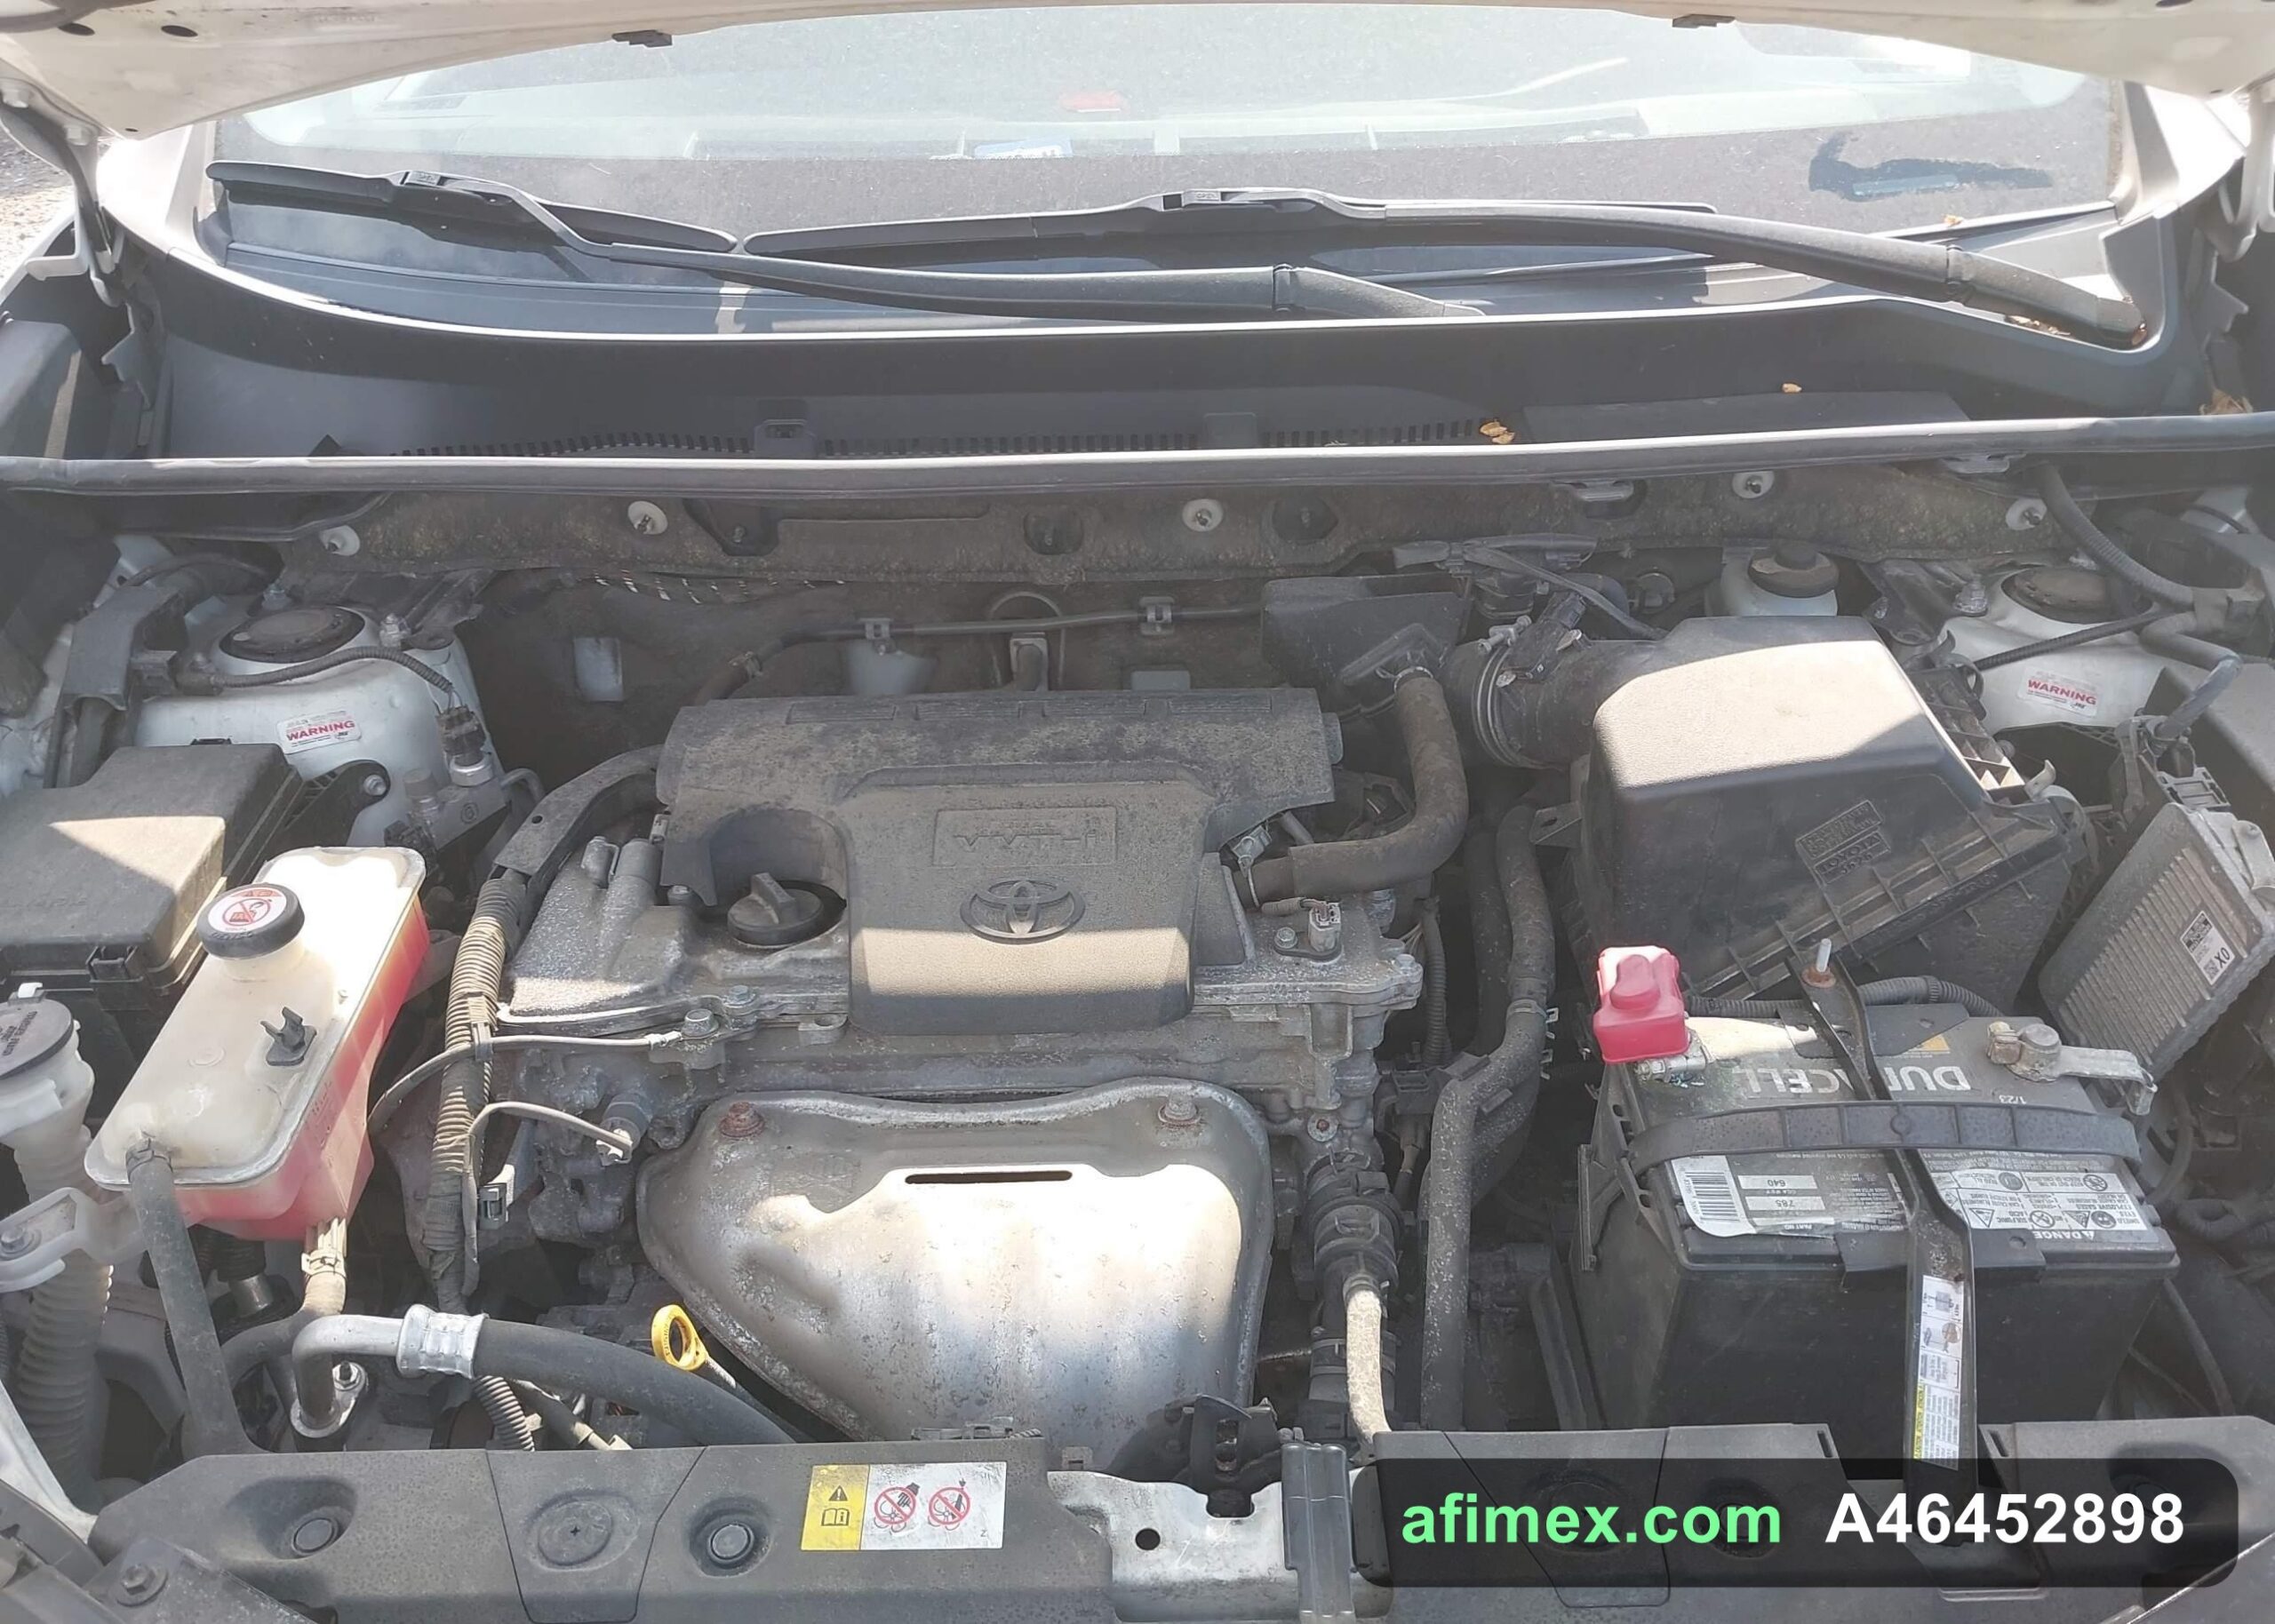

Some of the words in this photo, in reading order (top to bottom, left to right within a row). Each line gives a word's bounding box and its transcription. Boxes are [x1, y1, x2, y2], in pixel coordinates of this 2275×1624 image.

[2028, 680, 2097, 705] WARNING
[286, 720, 355, 741] WARNING
[1821, 832, 1880, 873] TOYOTA
[1732, 1064, 1971, 1094] DUCELL
[2000, 1094, 2027, 1104] 1/23
[1767, 1178, 1786, 1188] 640
[1774, 1198, 1795, 1208] 785
[2032, 1230, 2082, 1239] DANGE
